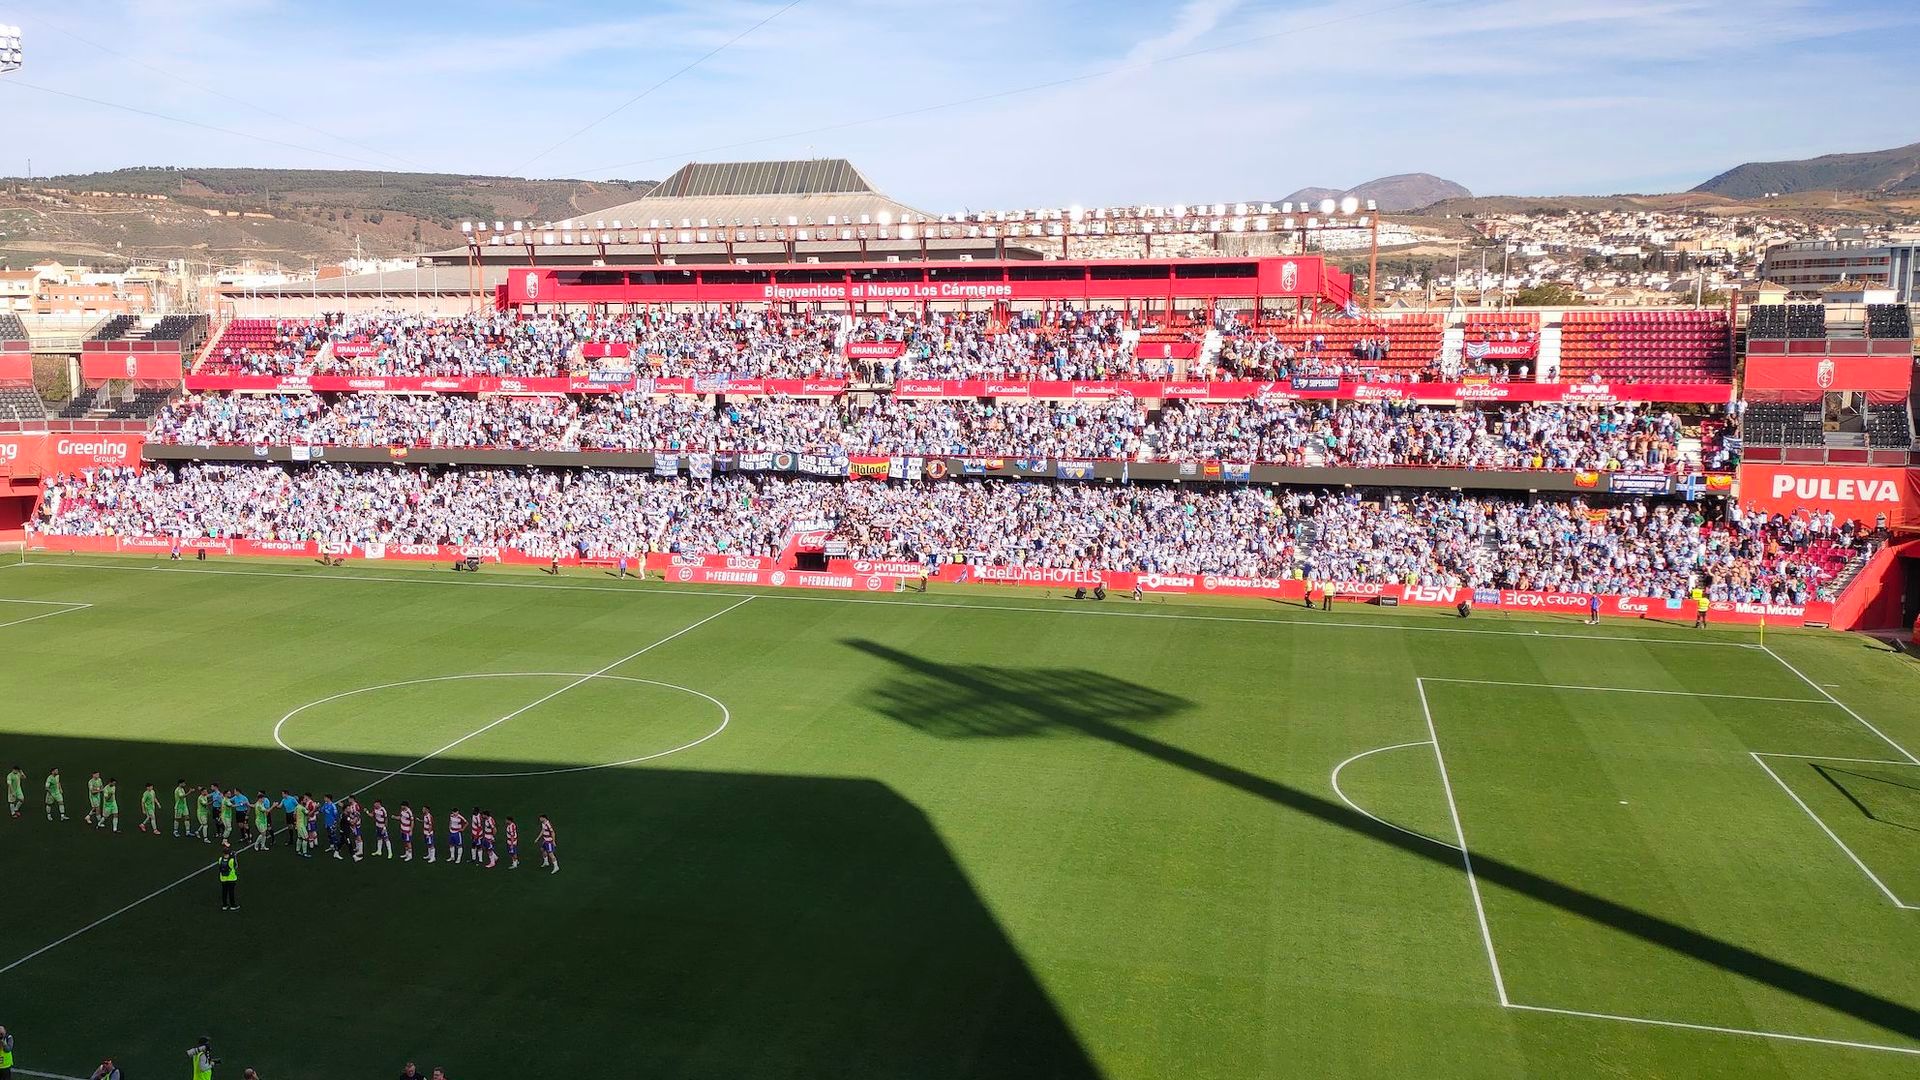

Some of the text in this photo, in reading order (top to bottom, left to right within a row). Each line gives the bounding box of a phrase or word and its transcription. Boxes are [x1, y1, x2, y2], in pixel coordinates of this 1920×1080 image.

[764, 283, 1012, 298] Bienvenidos al Nuevo Los Cármenes
[57, 439, 128, 458] Greening
[93, 455, 117, 465] Group
[850, 463, 887, 476] Málaga
[1772, 474, 1900, 502] PULEVA
[132, 537, 170, 547] CaixaBank
[189, 538, 227, 548] CaixaBank
[261, 541, 306, 551] aeroprint
[875, 563, 921, 573] HYUNDAI
[713, 572, 759, 583] FEDERACIÓN
[807, 576, 853, 588] FEDERACIÓN
[1314, 581, 1384, 594] MRACOF
[1403, 586, 1458, 603] HSN
[1736, 603, 1765, 614] Mica
[1766, 604, 1806, 616] Motor
